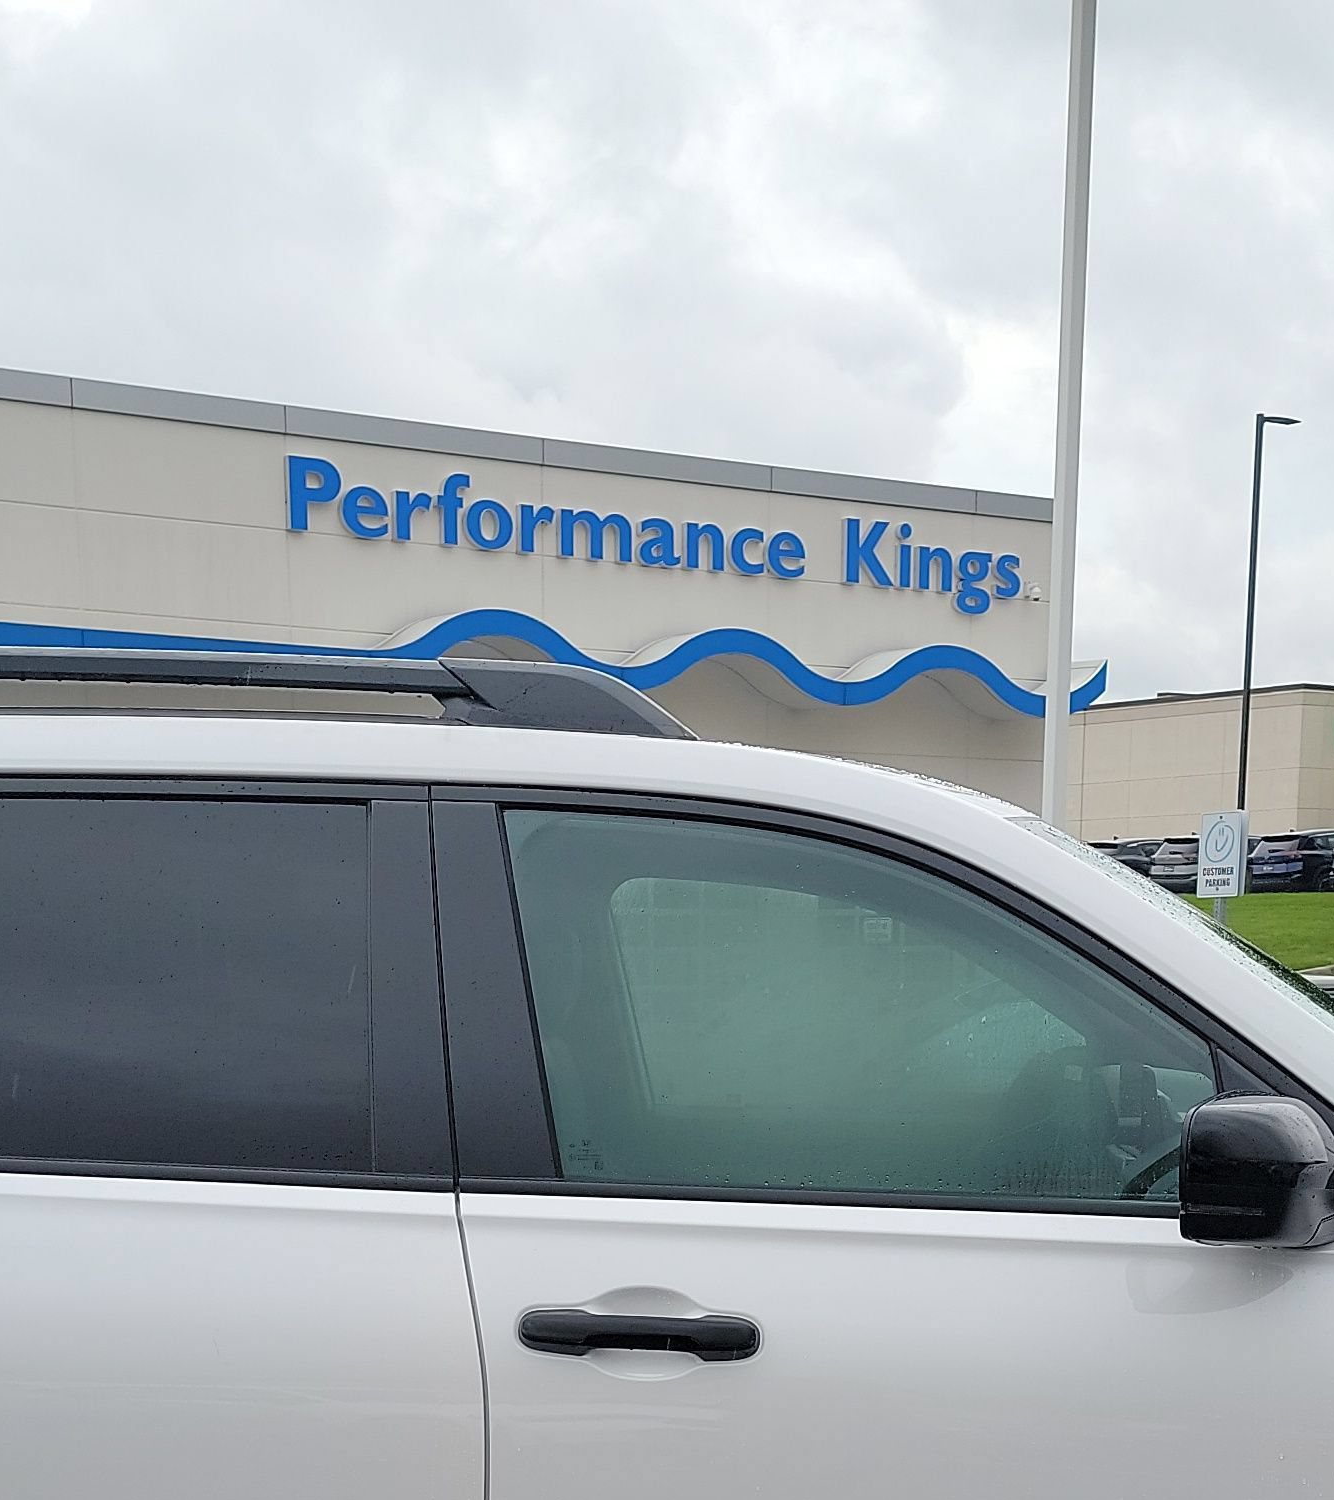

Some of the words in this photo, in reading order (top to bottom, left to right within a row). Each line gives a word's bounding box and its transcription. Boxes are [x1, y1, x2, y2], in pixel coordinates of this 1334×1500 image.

[286, 454, 807, 581] Performance
[841, 516, 1023, 616] Kings
[1202, 866, 1235, 877] CUSTOMER
[1204, 877, 1231, 888] PARKING
